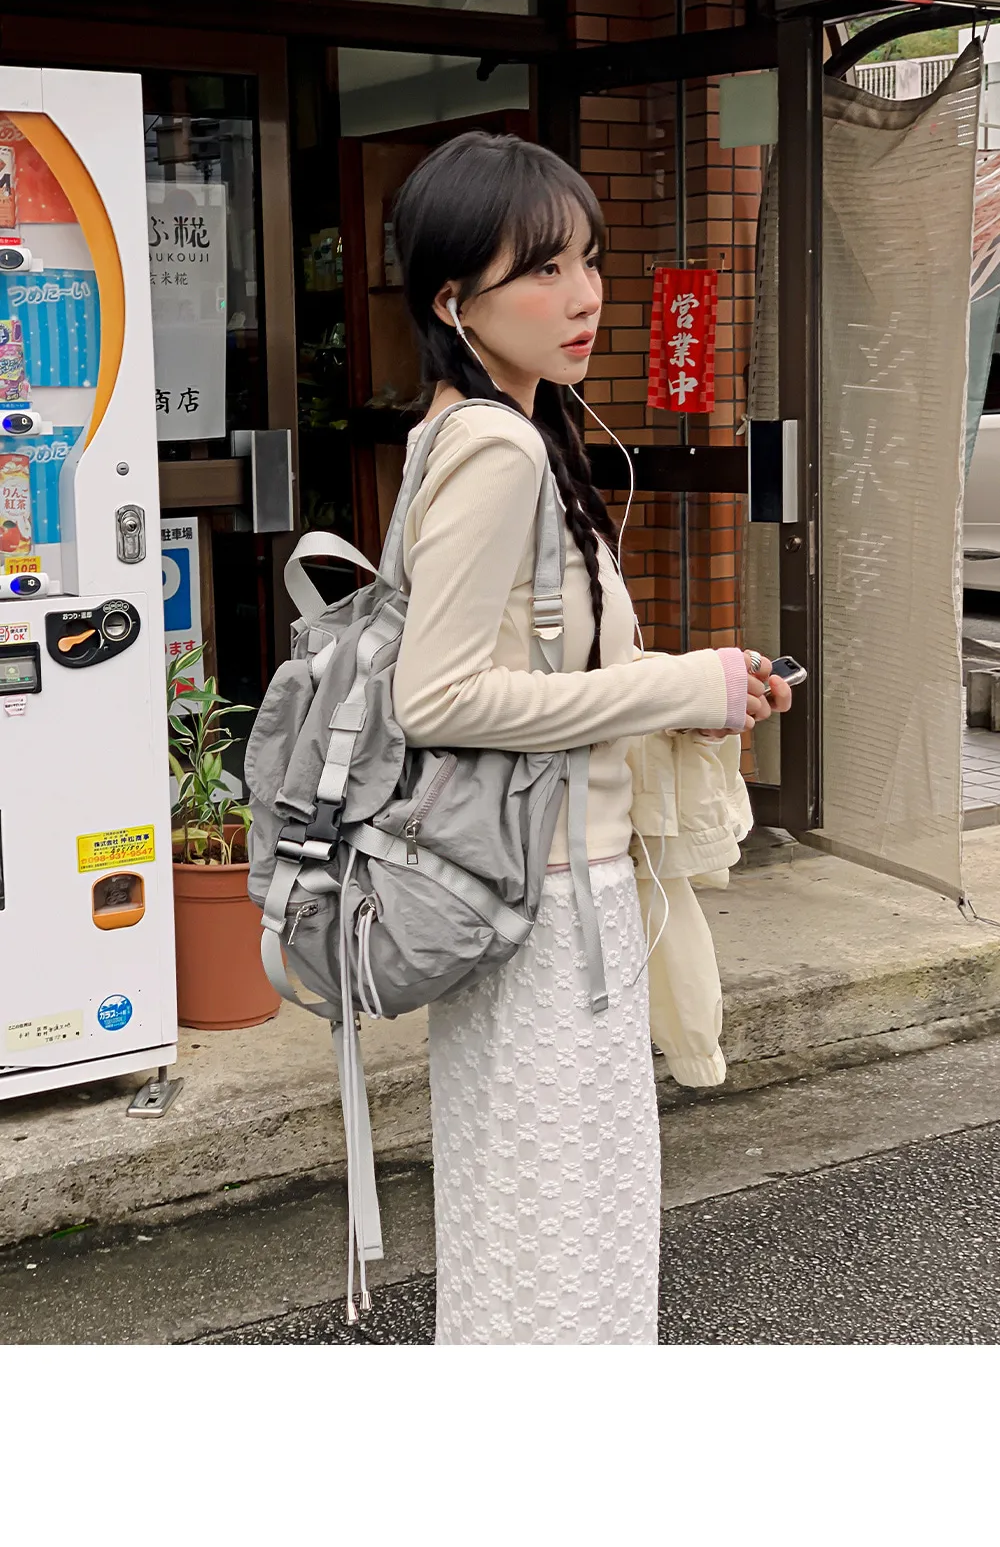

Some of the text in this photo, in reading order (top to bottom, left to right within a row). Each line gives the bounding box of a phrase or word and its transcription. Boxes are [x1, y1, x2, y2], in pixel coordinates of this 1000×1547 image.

[667, 293, 700, 406] 営業中
[3, 486, 29, 499] りんご
[4, 499, 27, 510] 紅茶
[161, 527, 193, 542] 駐車場
[9, 564, 38, 573] 110円
[13, 633, 25, 641] OK
[165, 639, 196, 656] ます
